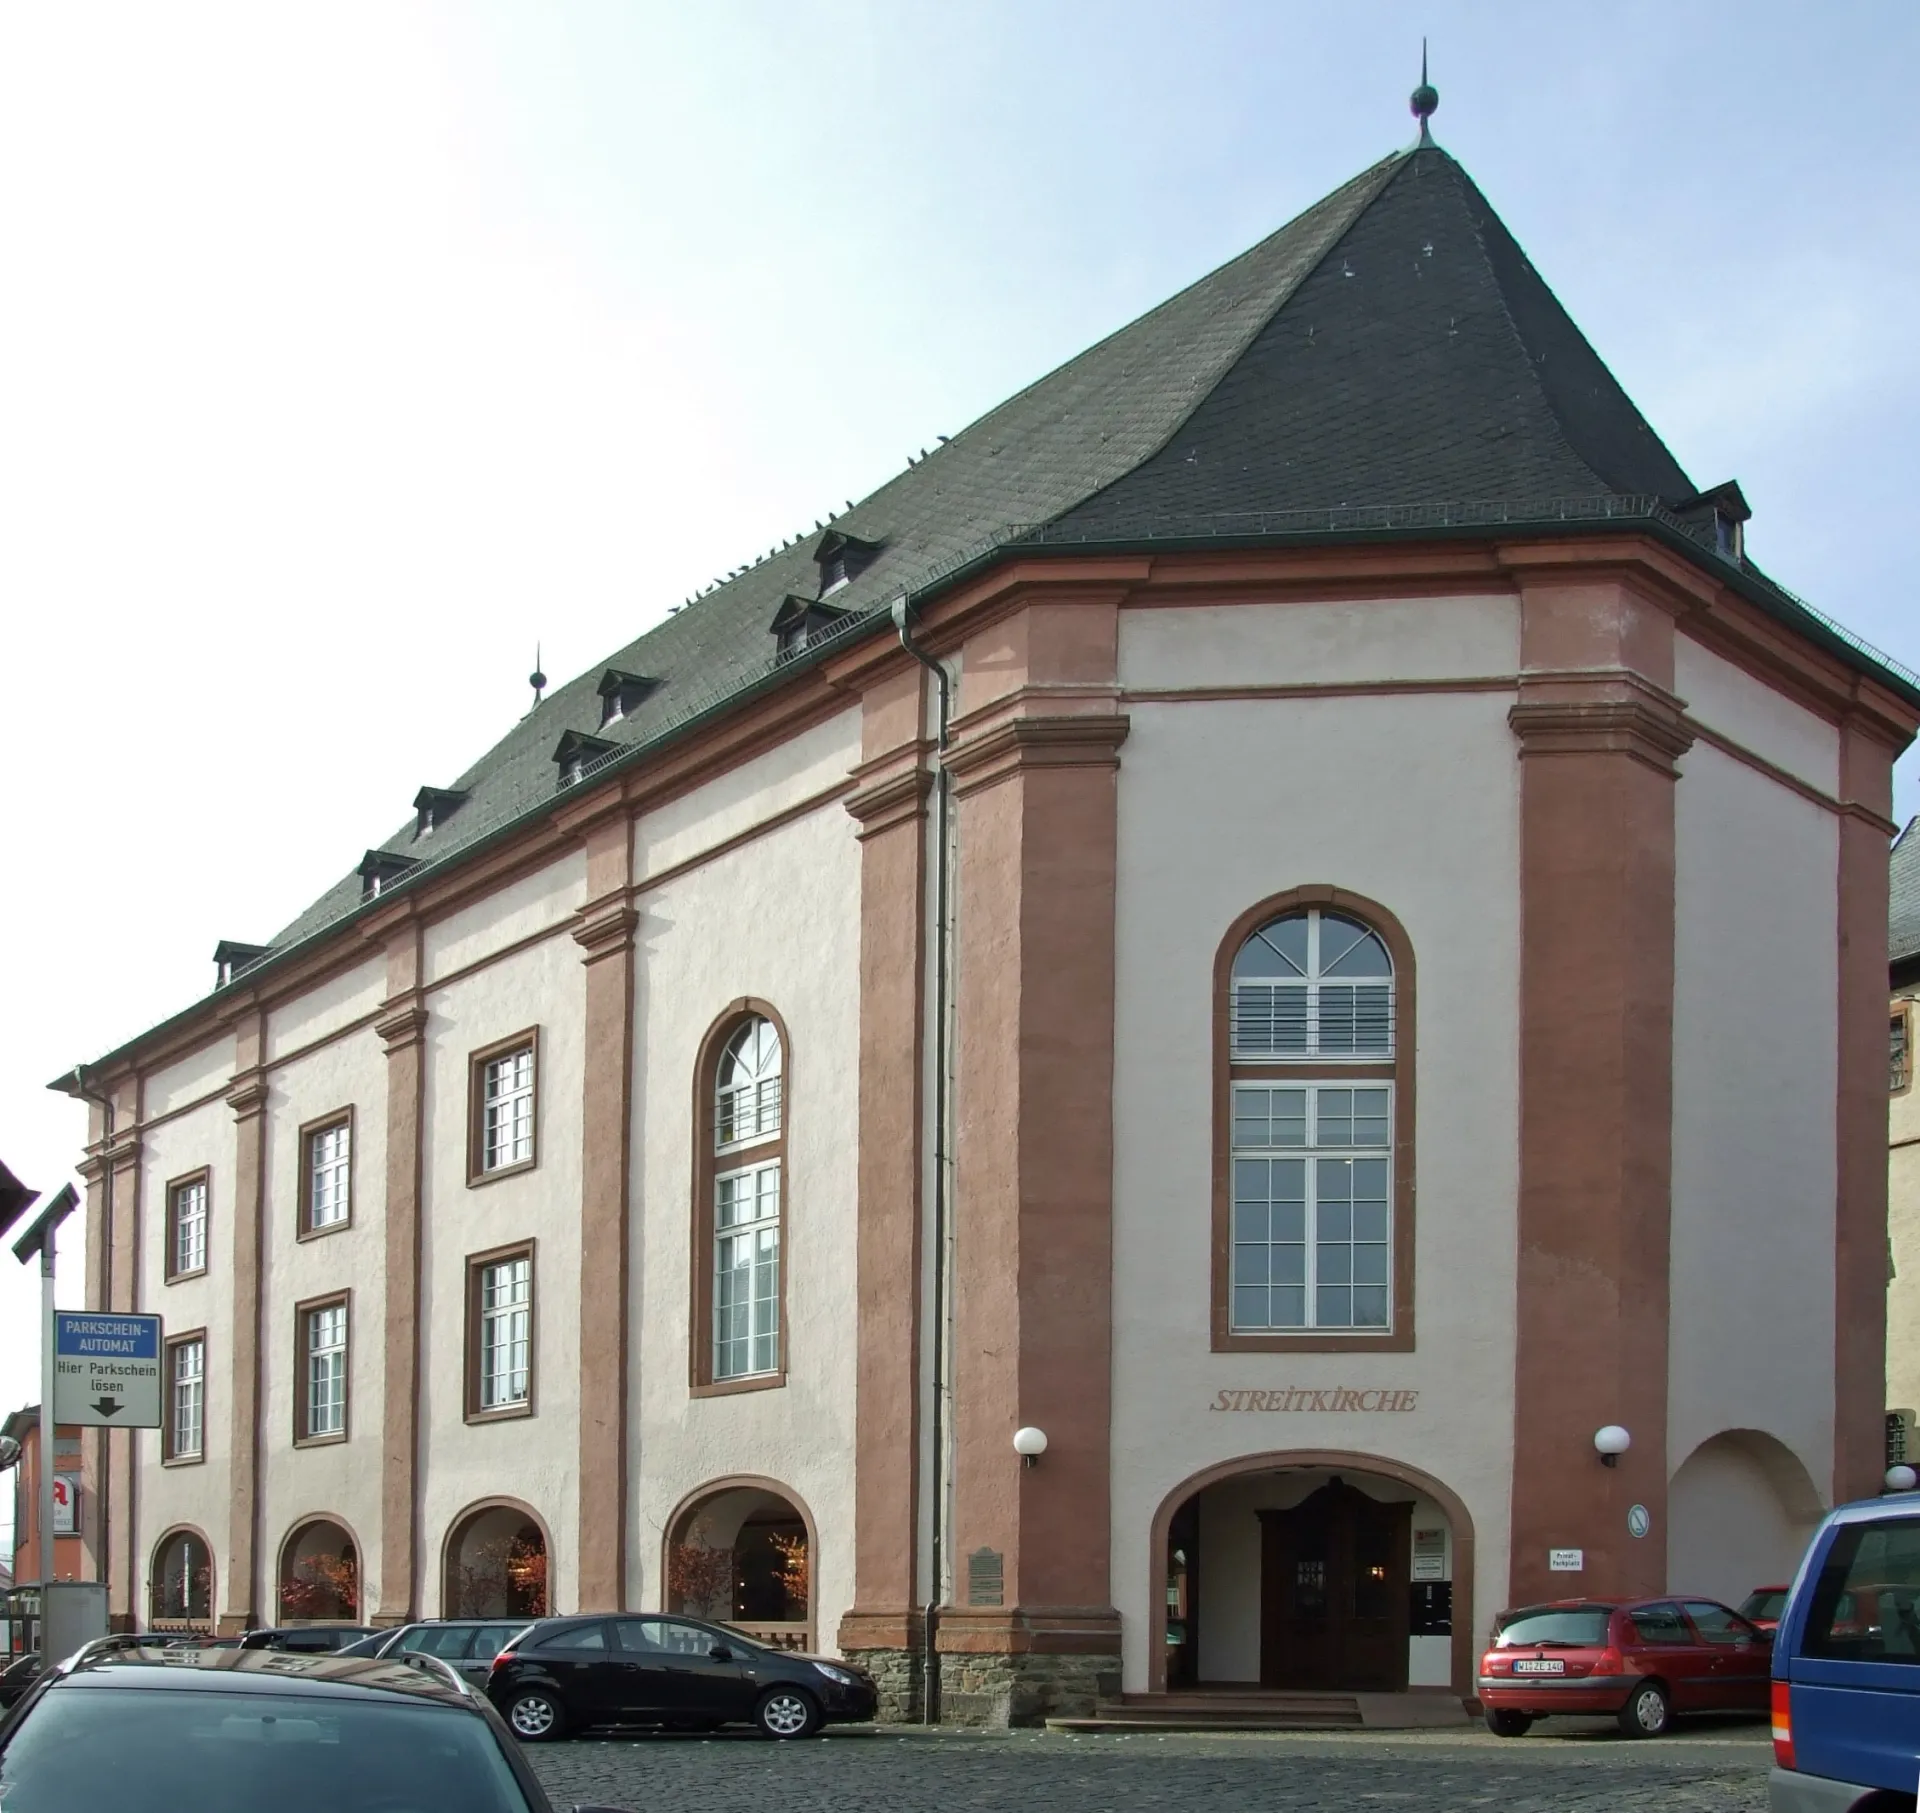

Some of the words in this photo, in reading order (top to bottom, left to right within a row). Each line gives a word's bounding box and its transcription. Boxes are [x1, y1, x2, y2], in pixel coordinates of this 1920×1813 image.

[66, 1321, 149, 1336] PARKSCHEIN-
[79, 1339, 136, 1352] AUTOMAT
[58, 1361, 83, 1373] Hier
[90, 1362, 157, 1376] Parkschein
[91, 1379, 123, 1392] lösen
